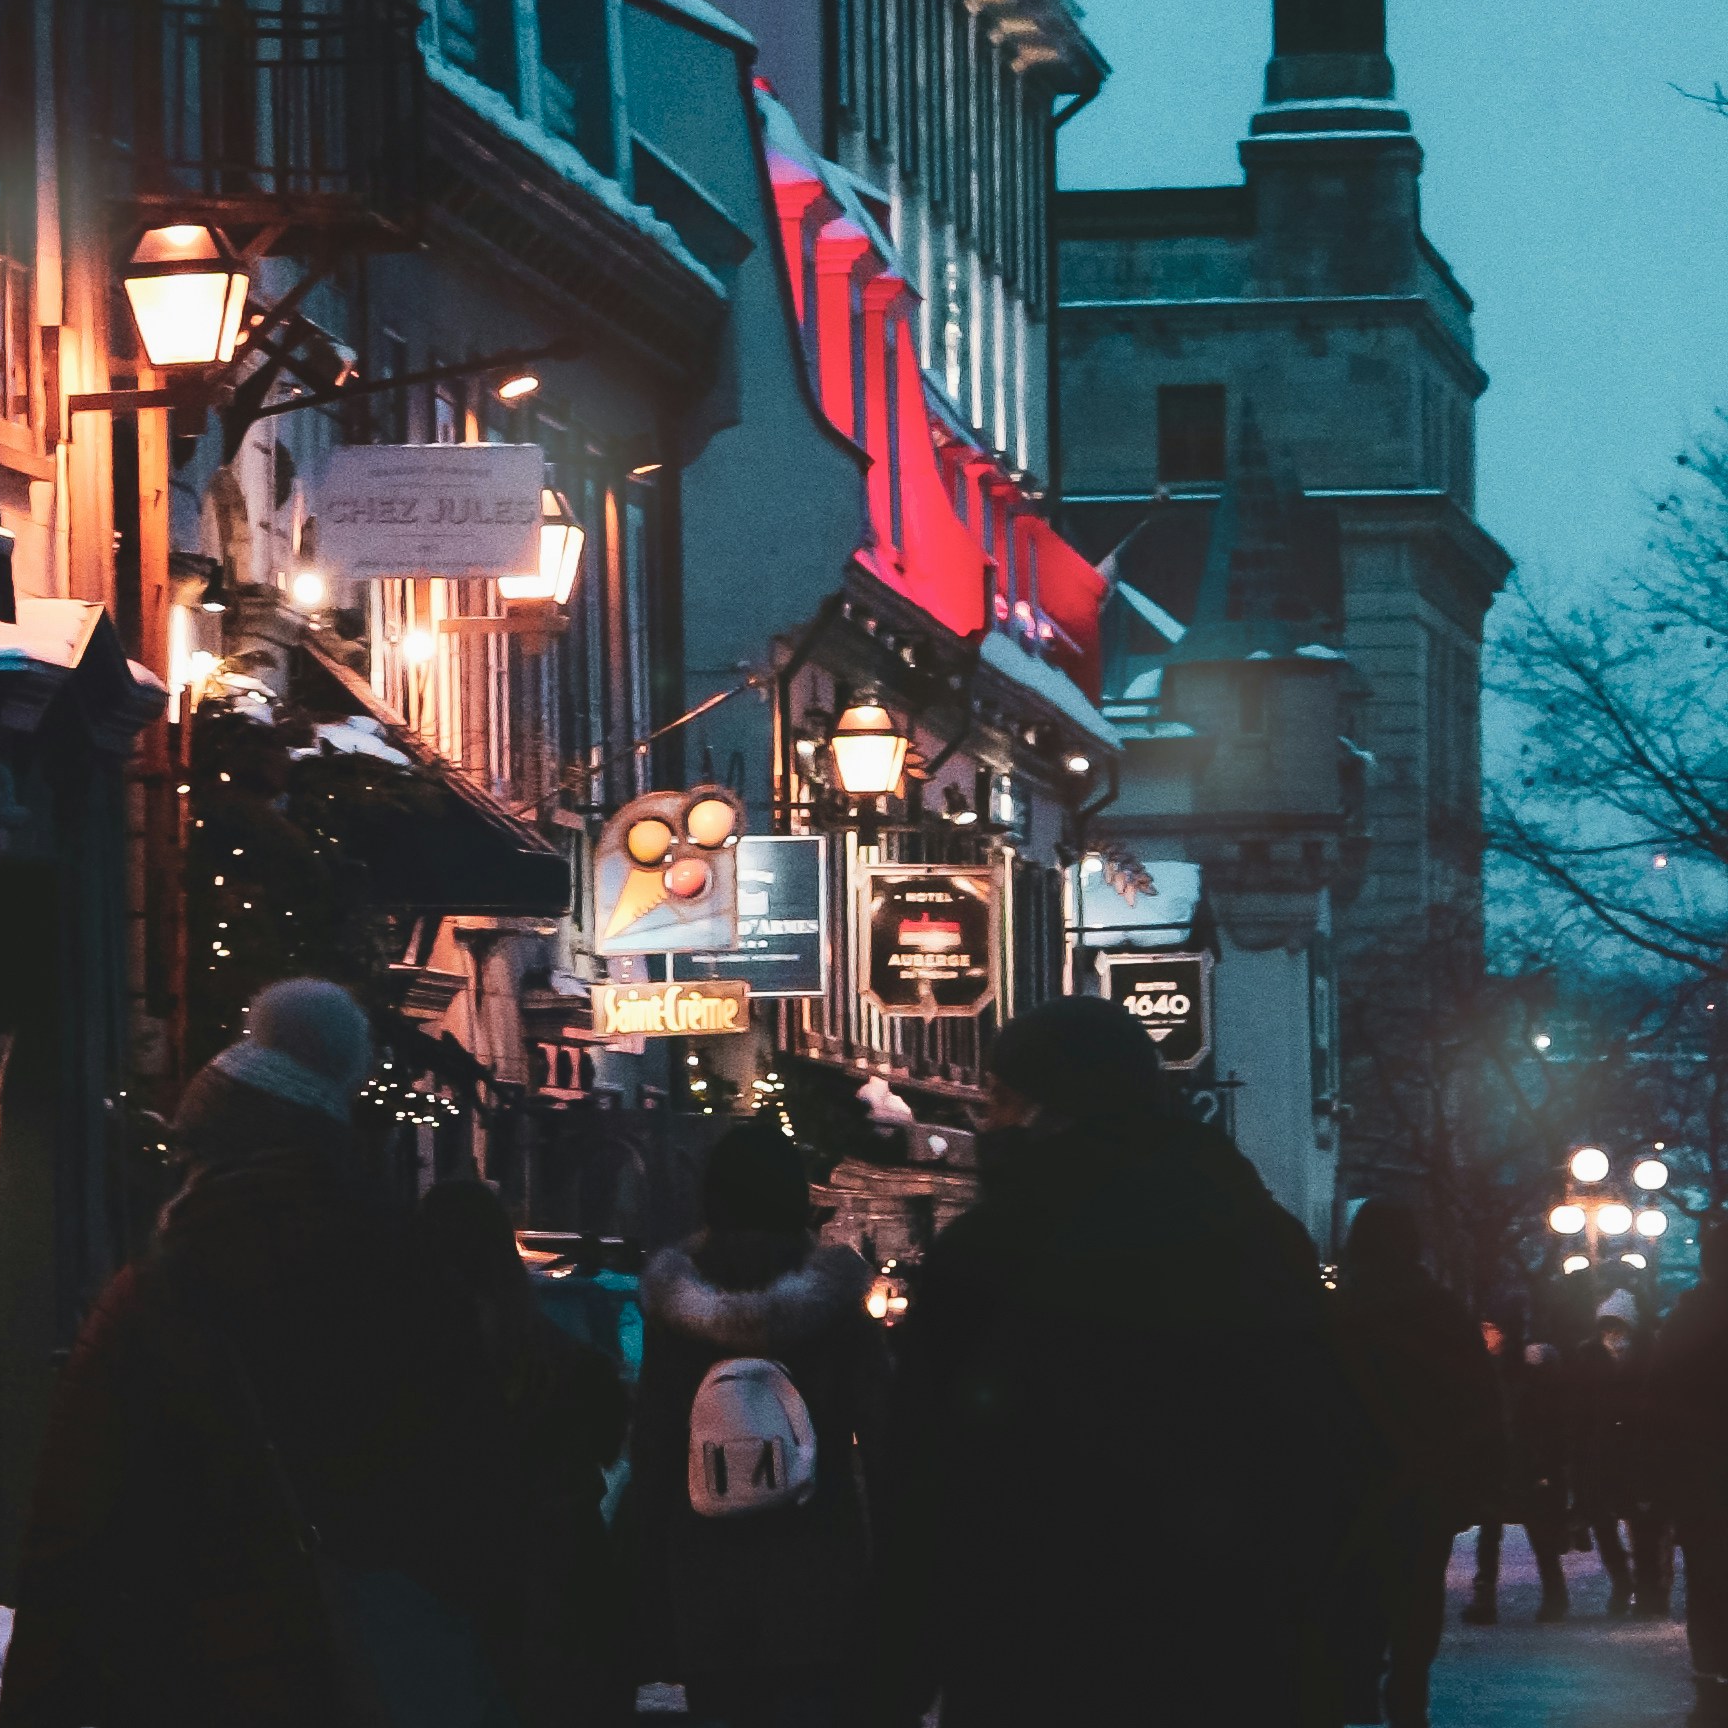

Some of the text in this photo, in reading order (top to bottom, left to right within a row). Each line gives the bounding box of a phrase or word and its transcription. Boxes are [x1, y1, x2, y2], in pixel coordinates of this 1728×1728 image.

[327, 496, 536, 525] CHEZ JULES
[888, 953, 970, 967] AUBERGE
[1123, 994, 1190, 1016] 1640
